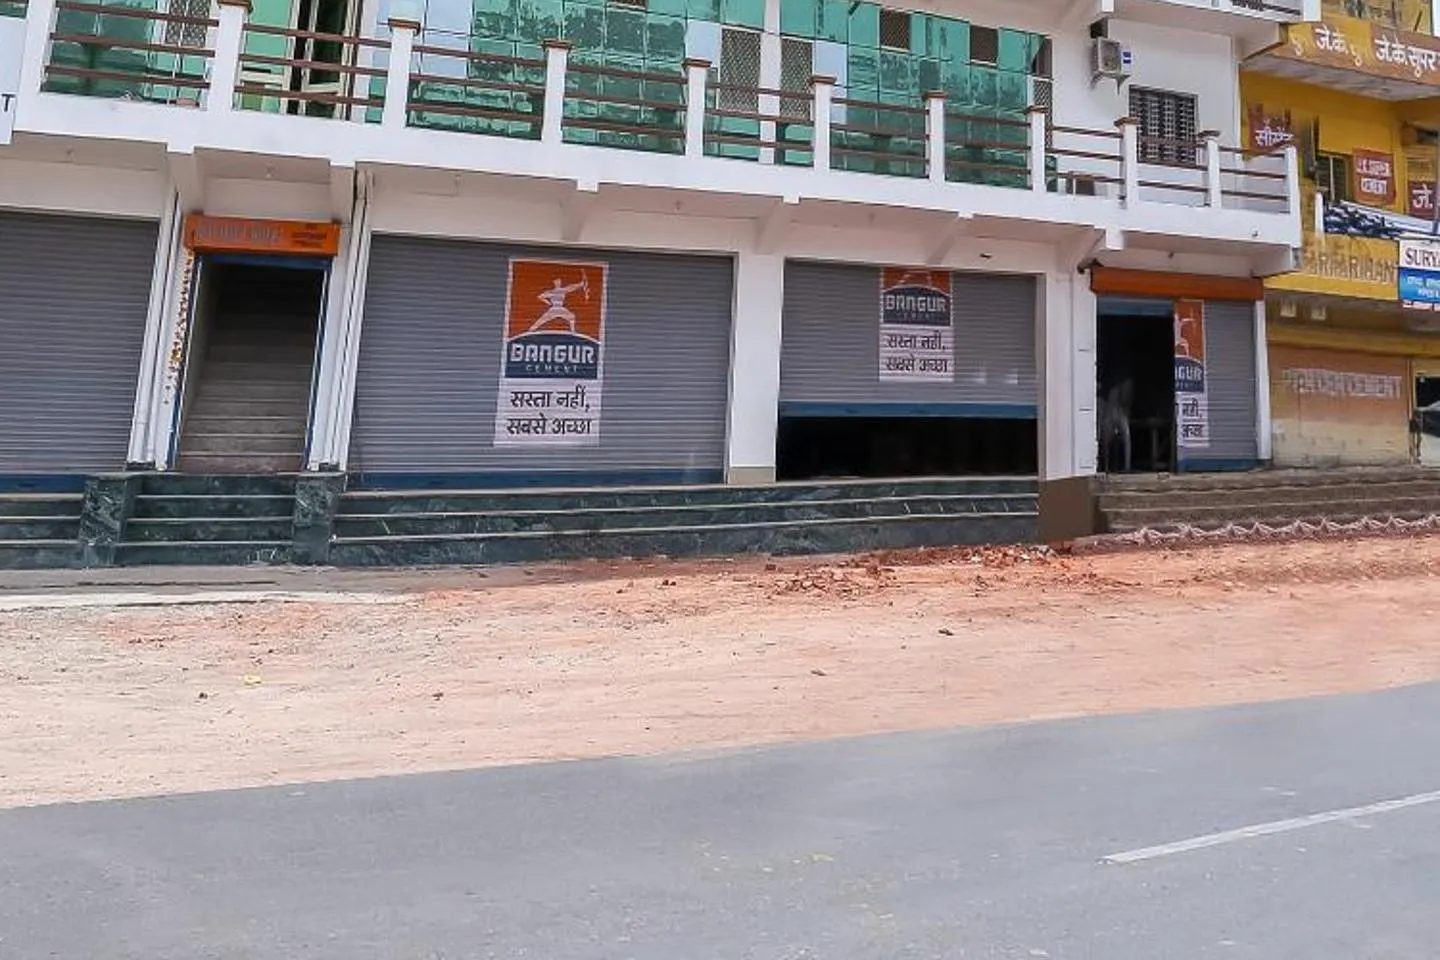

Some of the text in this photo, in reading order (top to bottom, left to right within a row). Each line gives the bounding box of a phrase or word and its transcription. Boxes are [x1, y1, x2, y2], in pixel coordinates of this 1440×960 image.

[885, 294, 946, 312] BANGUR
[510, 344, 595, 364] BANGUR
[510, 391, 553, 408] सस्ता
[506, 413, 591, 435] सबसे अच्छा
